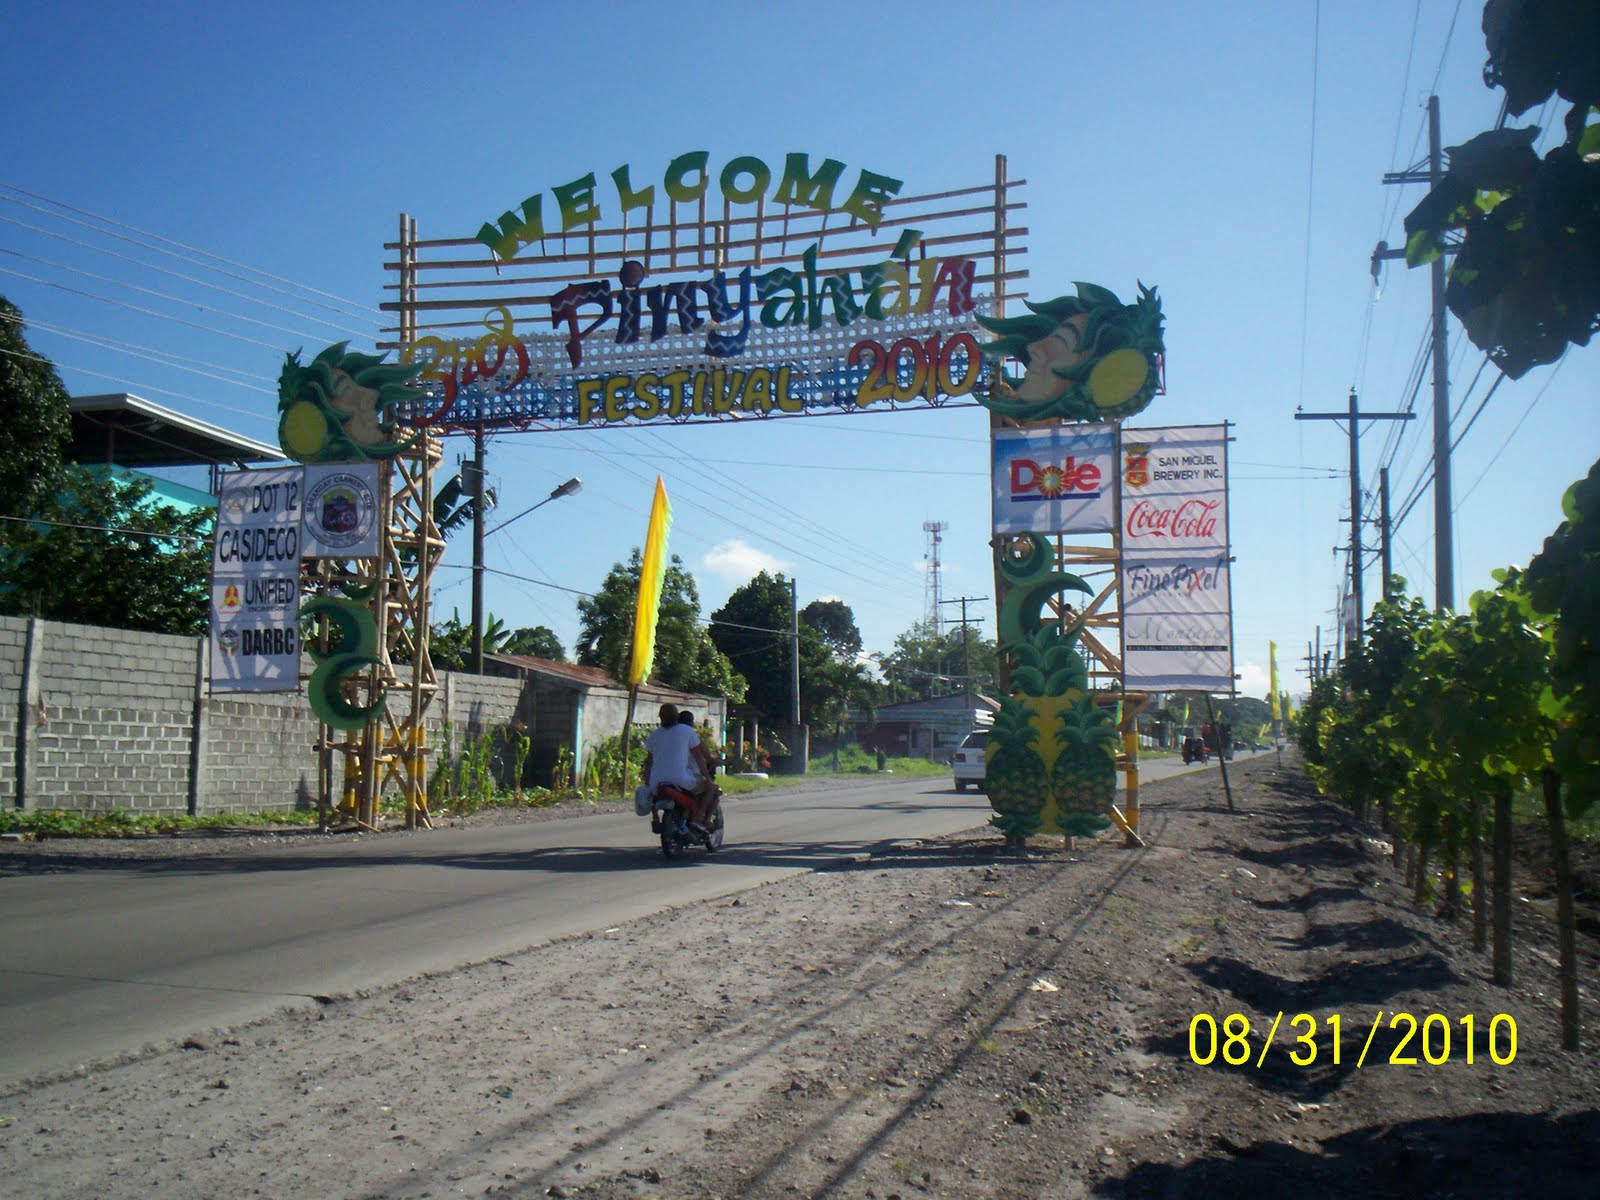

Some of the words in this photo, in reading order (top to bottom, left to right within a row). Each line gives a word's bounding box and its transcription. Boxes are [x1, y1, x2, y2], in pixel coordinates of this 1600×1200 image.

[475, 151, 904, 262] WELCOME
[577, 365, 805, 425] FESTIVAL
[849, 330, 982, 409] 2010
[1010, 456, 1102, 496] Dole
[1153, 469, 1201, 480] BREWERY
[1203, 469, 1223, 479] INC.
[1158, 456, 1180, 467] SAN
[1182, 455, 1217, 466] MIGUEL
[252, 484, 280, 513] DOT
[284, 481, 298, 512] 12
[220, 526, 297, 563] CASIDECO
[245, 578, 295, 605] UNIFIED
[242, 628, 295, 656] DARBC
